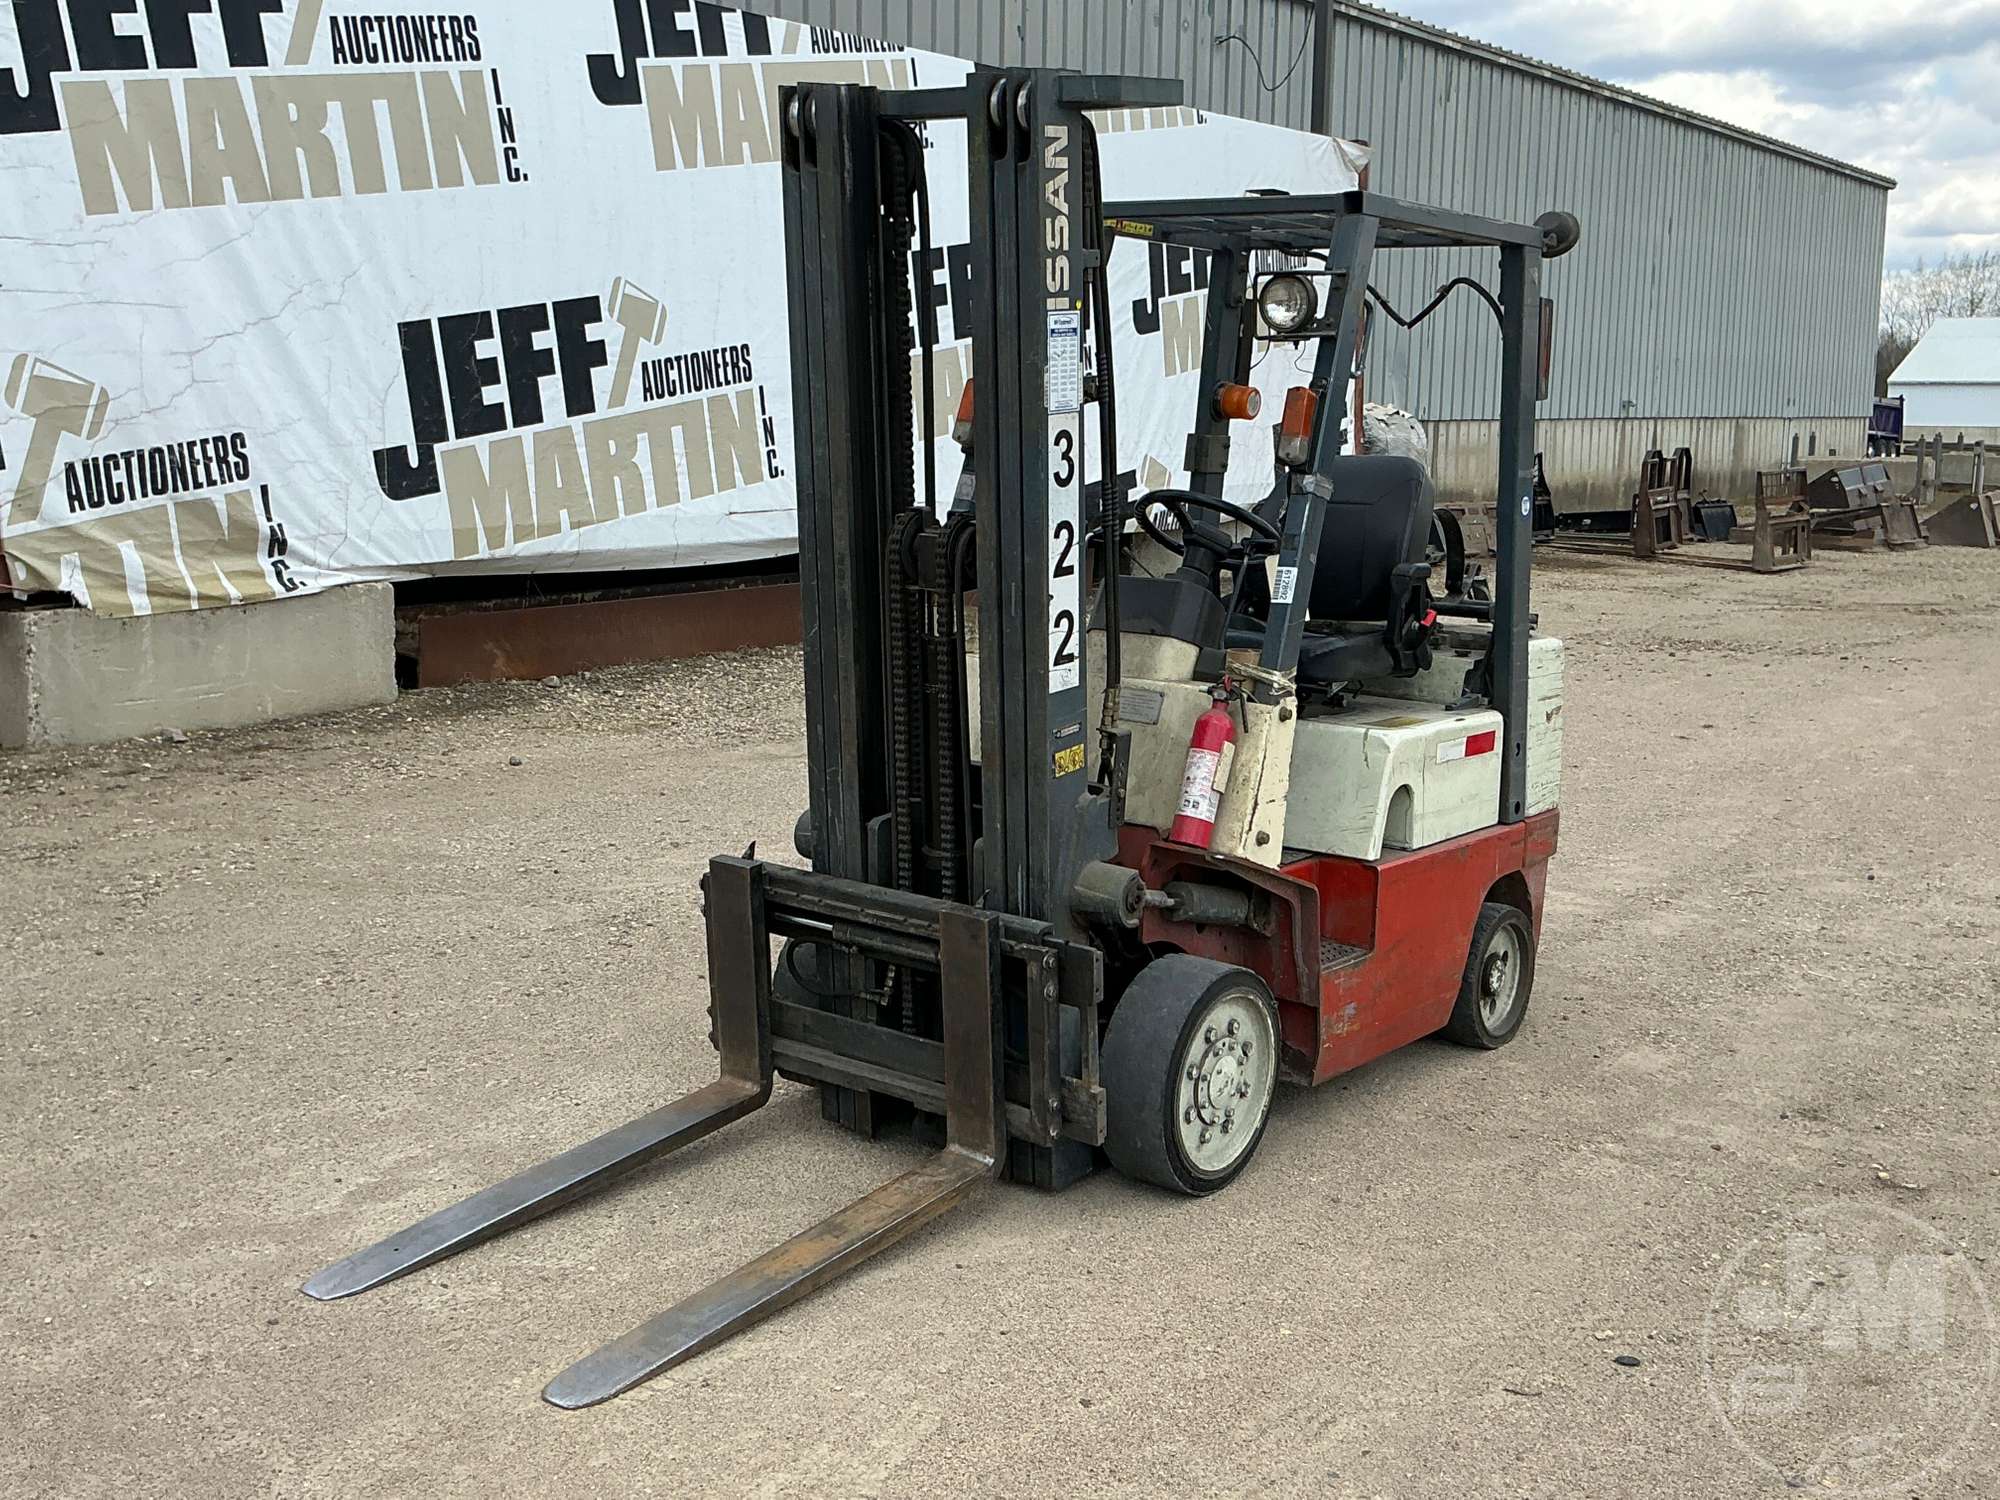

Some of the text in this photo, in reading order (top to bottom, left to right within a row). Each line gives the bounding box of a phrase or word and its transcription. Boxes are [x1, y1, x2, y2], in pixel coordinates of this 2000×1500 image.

[329, 15, 482, 64] AUCTIONEERS
[60, 70, 501, 216] MARTIN
[1045, 125, 1070, 311] ISSAN
[373, 295, 608, 501] JEFF
[641, 343, 753, 403] AUCTIONEERS
[64, 432, 251, 513] AUCTIONEERS
[440, 388, 764, 561] MARTIN
